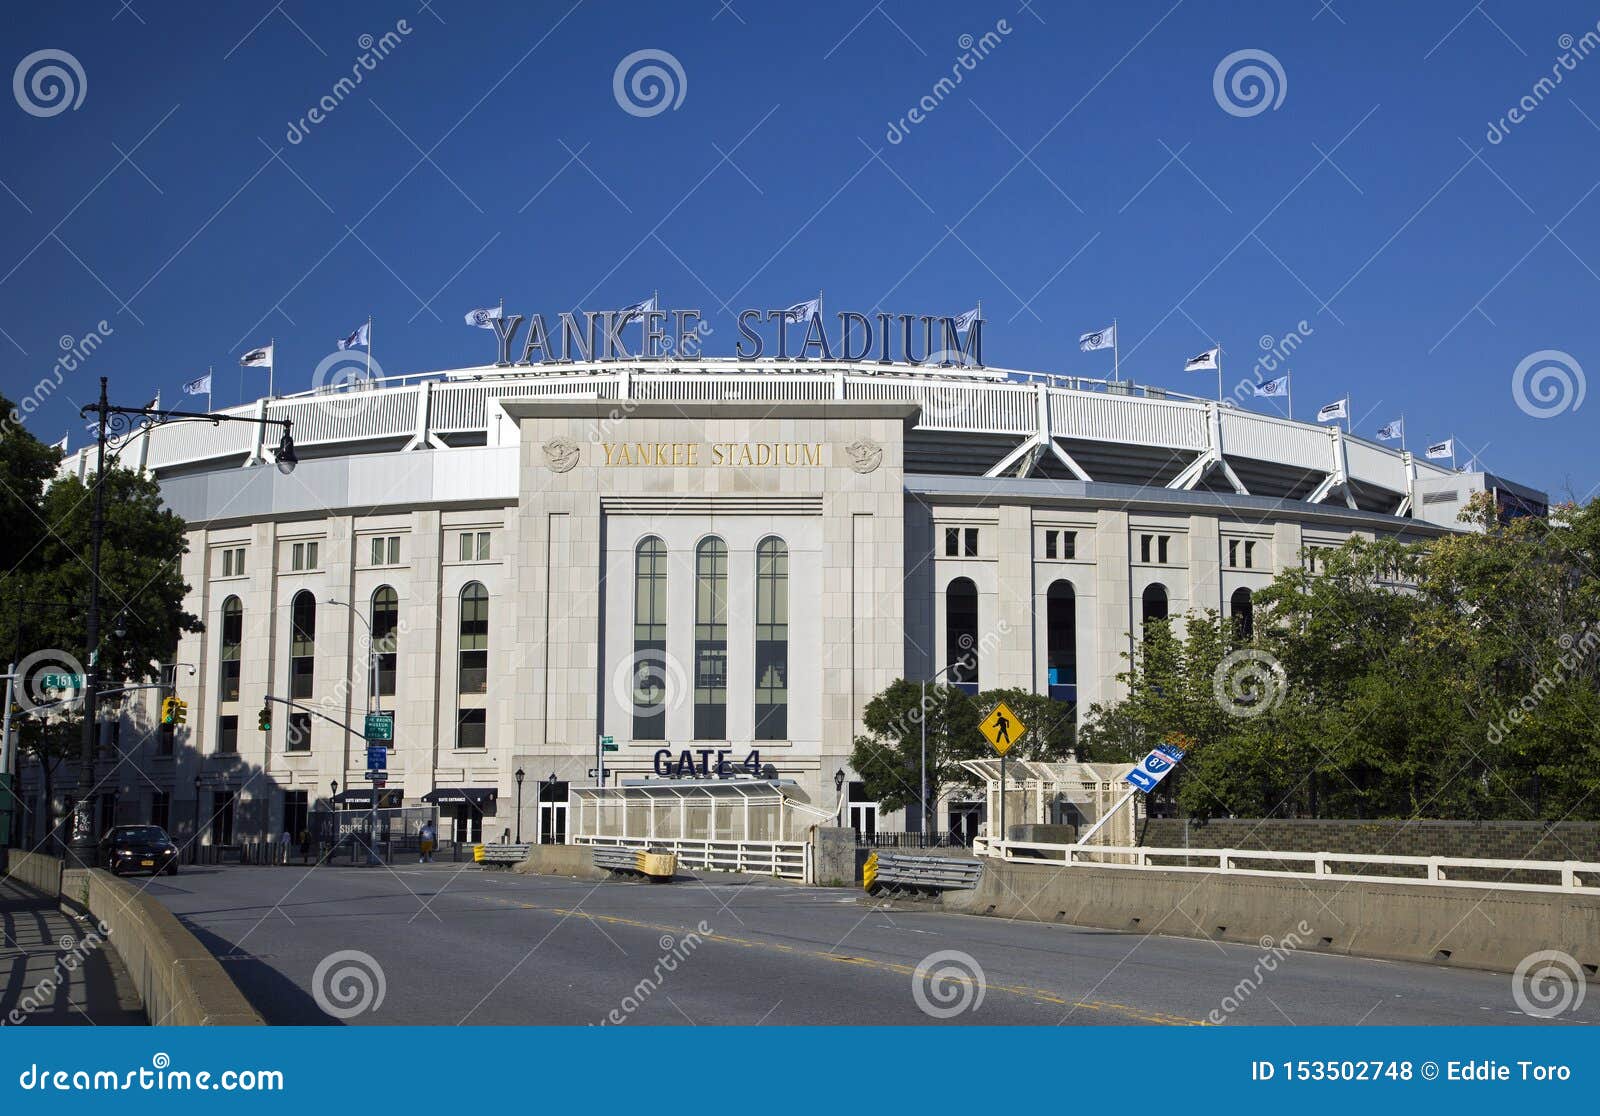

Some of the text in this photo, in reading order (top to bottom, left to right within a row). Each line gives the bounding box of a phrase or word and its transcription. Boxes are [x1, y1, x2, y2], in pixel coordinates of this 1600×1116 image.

[487, 308, 986, 369] YANKEE STADIUM
[601, 442, 824, 467] YANKEE STADIUM
[46, 675, 52, 686] E
[56, 675, 71, 686] 161
[653, 749, 761, 778] GATE 4
[1148, 757, 1167, 769] 87
